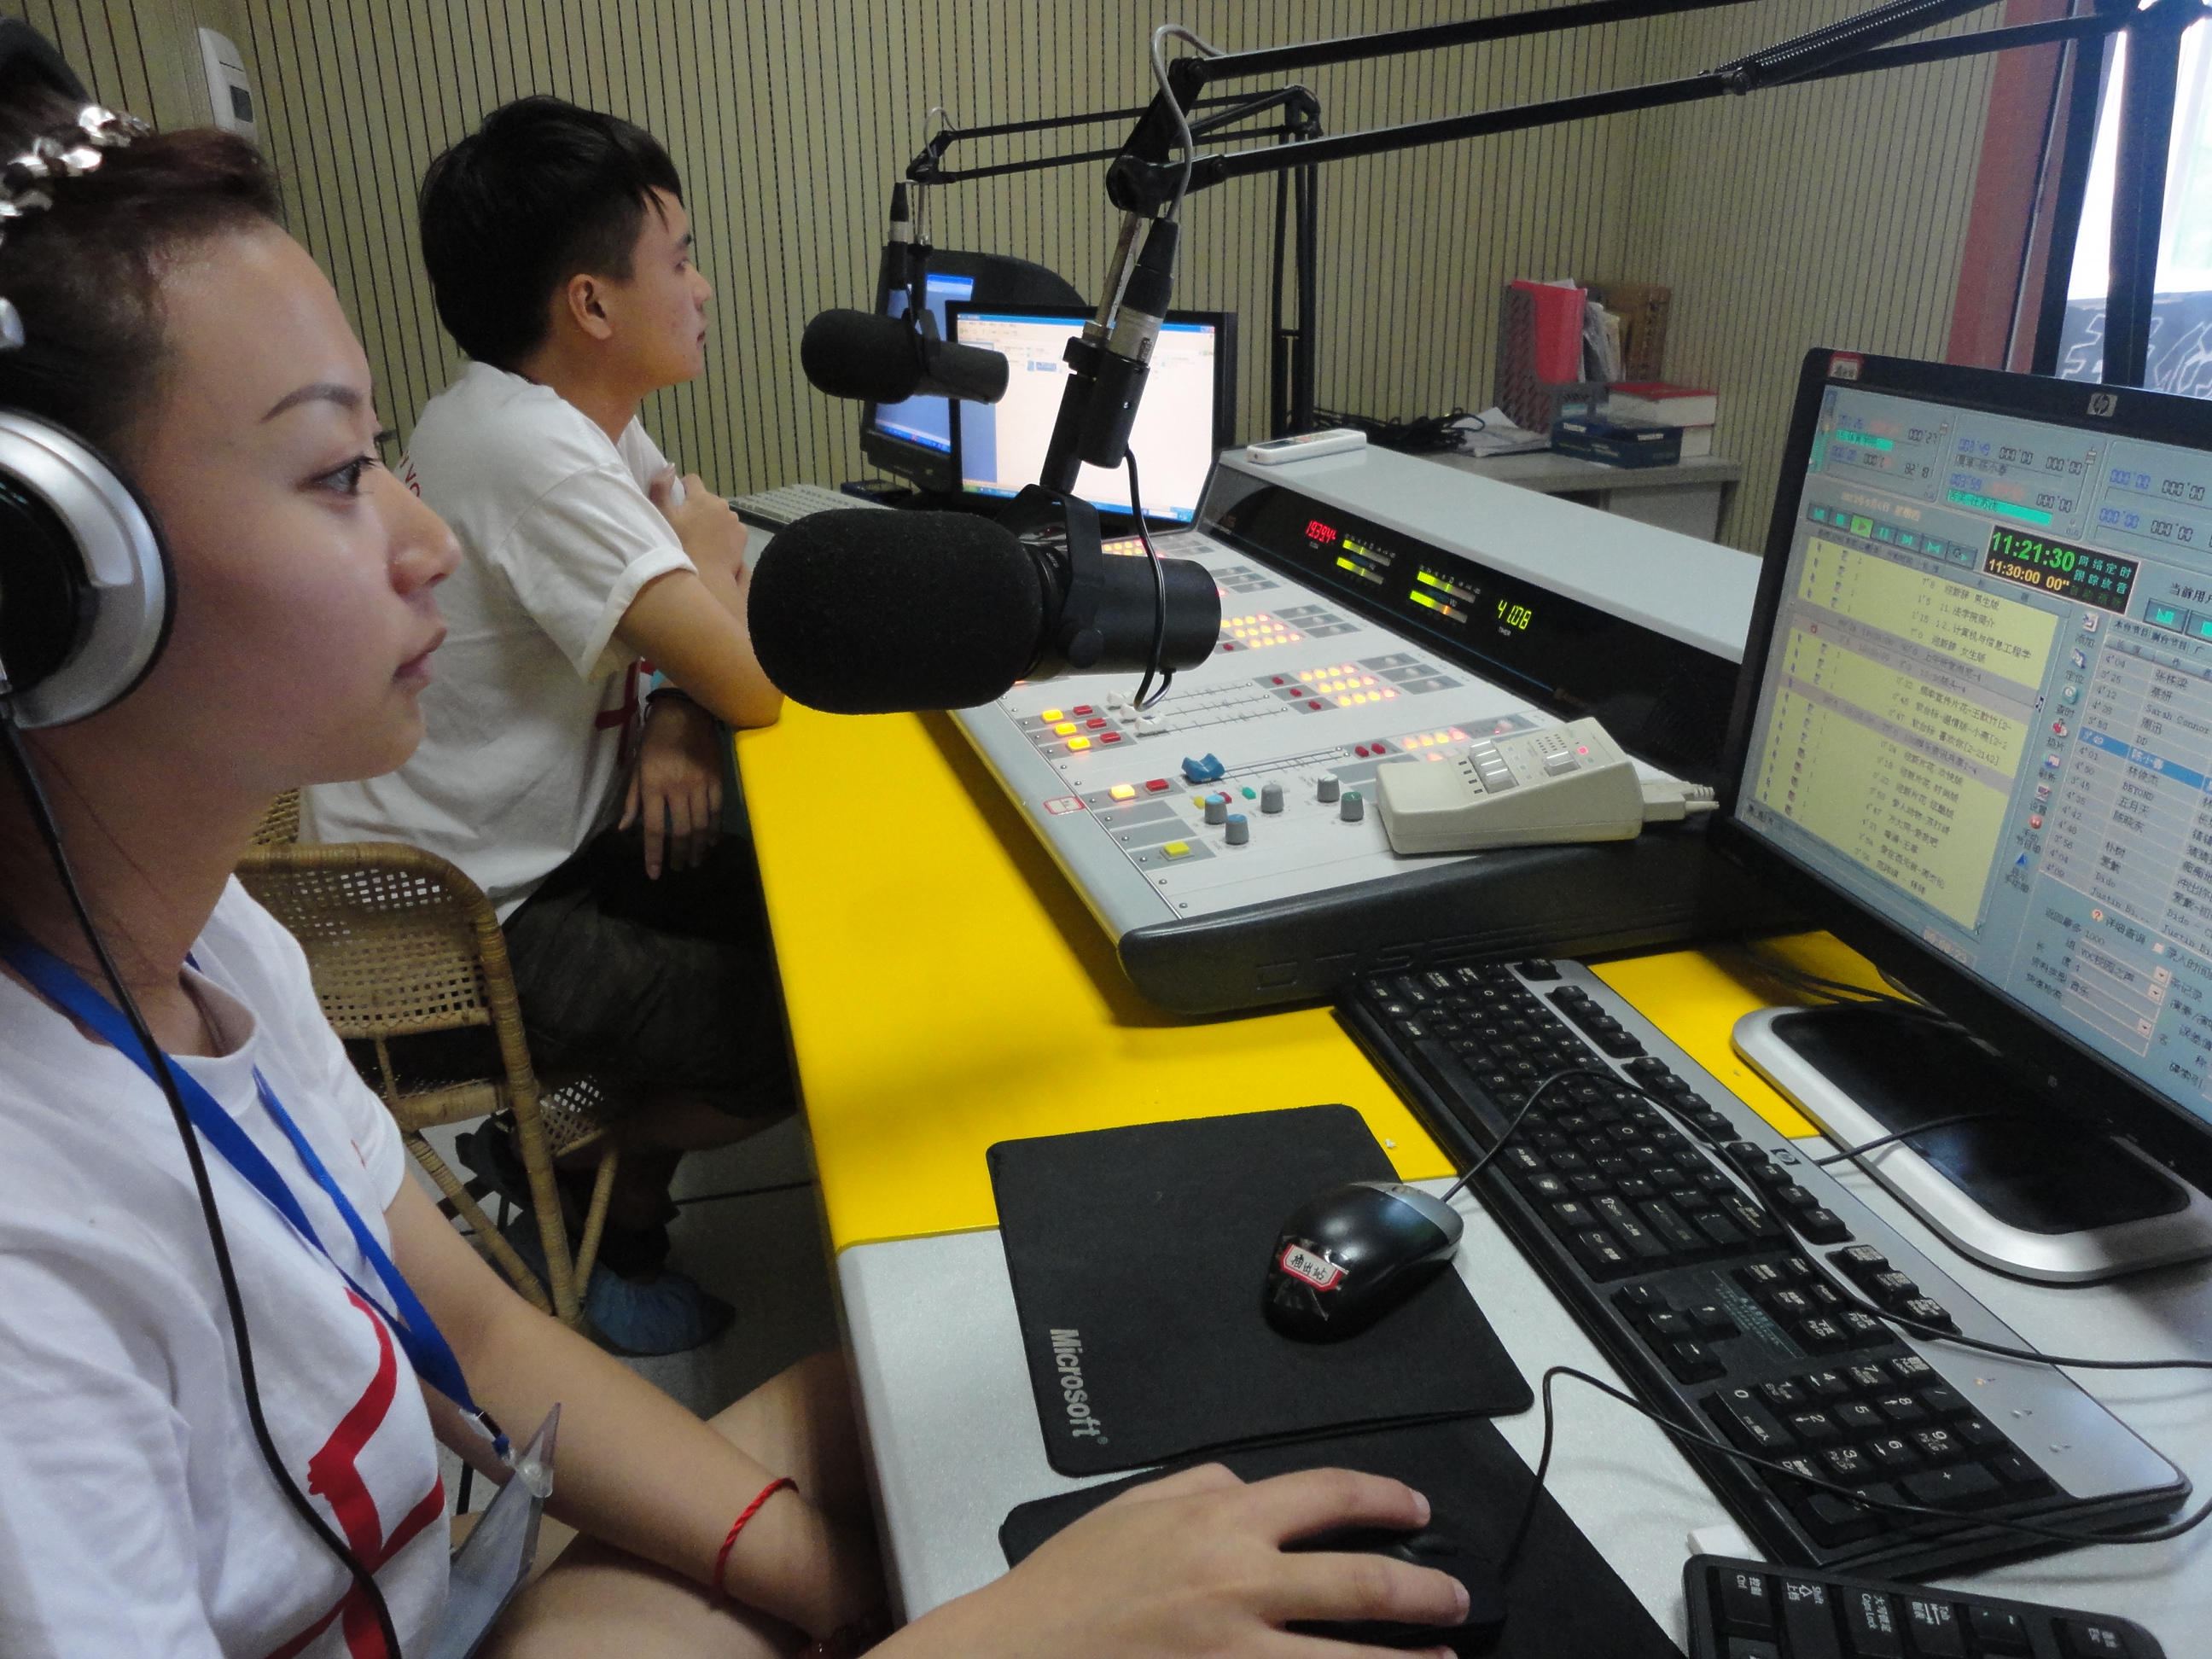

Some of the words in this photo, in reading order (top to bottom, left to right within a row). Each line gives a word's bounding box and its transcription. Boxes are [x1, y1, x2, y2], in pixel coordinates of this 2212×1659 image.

[1993, 532, 2075, 572] 11:21:30
[1989, 558, 2040, 585] 11:30:00
[2064, 670, 2084, 684] 定位
[2145, 704, 2173, 720] Sarah
[2122, 782, 2154, 802] BEYOND
[2117, 795, 2150, 818] 五月天
[2091, 886, 2122, 909] Justin
[2178, 879, 2212, 902] 冲出你
[2085, 929, 2104, 946] 1000
[2070, 979, 2089, 998] 音乐
[1823, 1372, 1836, 1381] 4
[1864, 1365, 1878, 1373] 7
[1050, 1329, 1101, 1437] Microsoft
[1810, 1414, 1825, 1423] 2
[1932, 1431, 1947, 1440] 9
[1843, 1449, 1857, 1458] 3
[1889, 1441, 1903, 1449] 6
[1737, 1575, 1748, 1590] Ctrl
[1812, 1585, 1825, 1604] Shift
[1861, 1593, 1871, 1612] Caps
[1866, 1612, 1878, 1630] Lock
